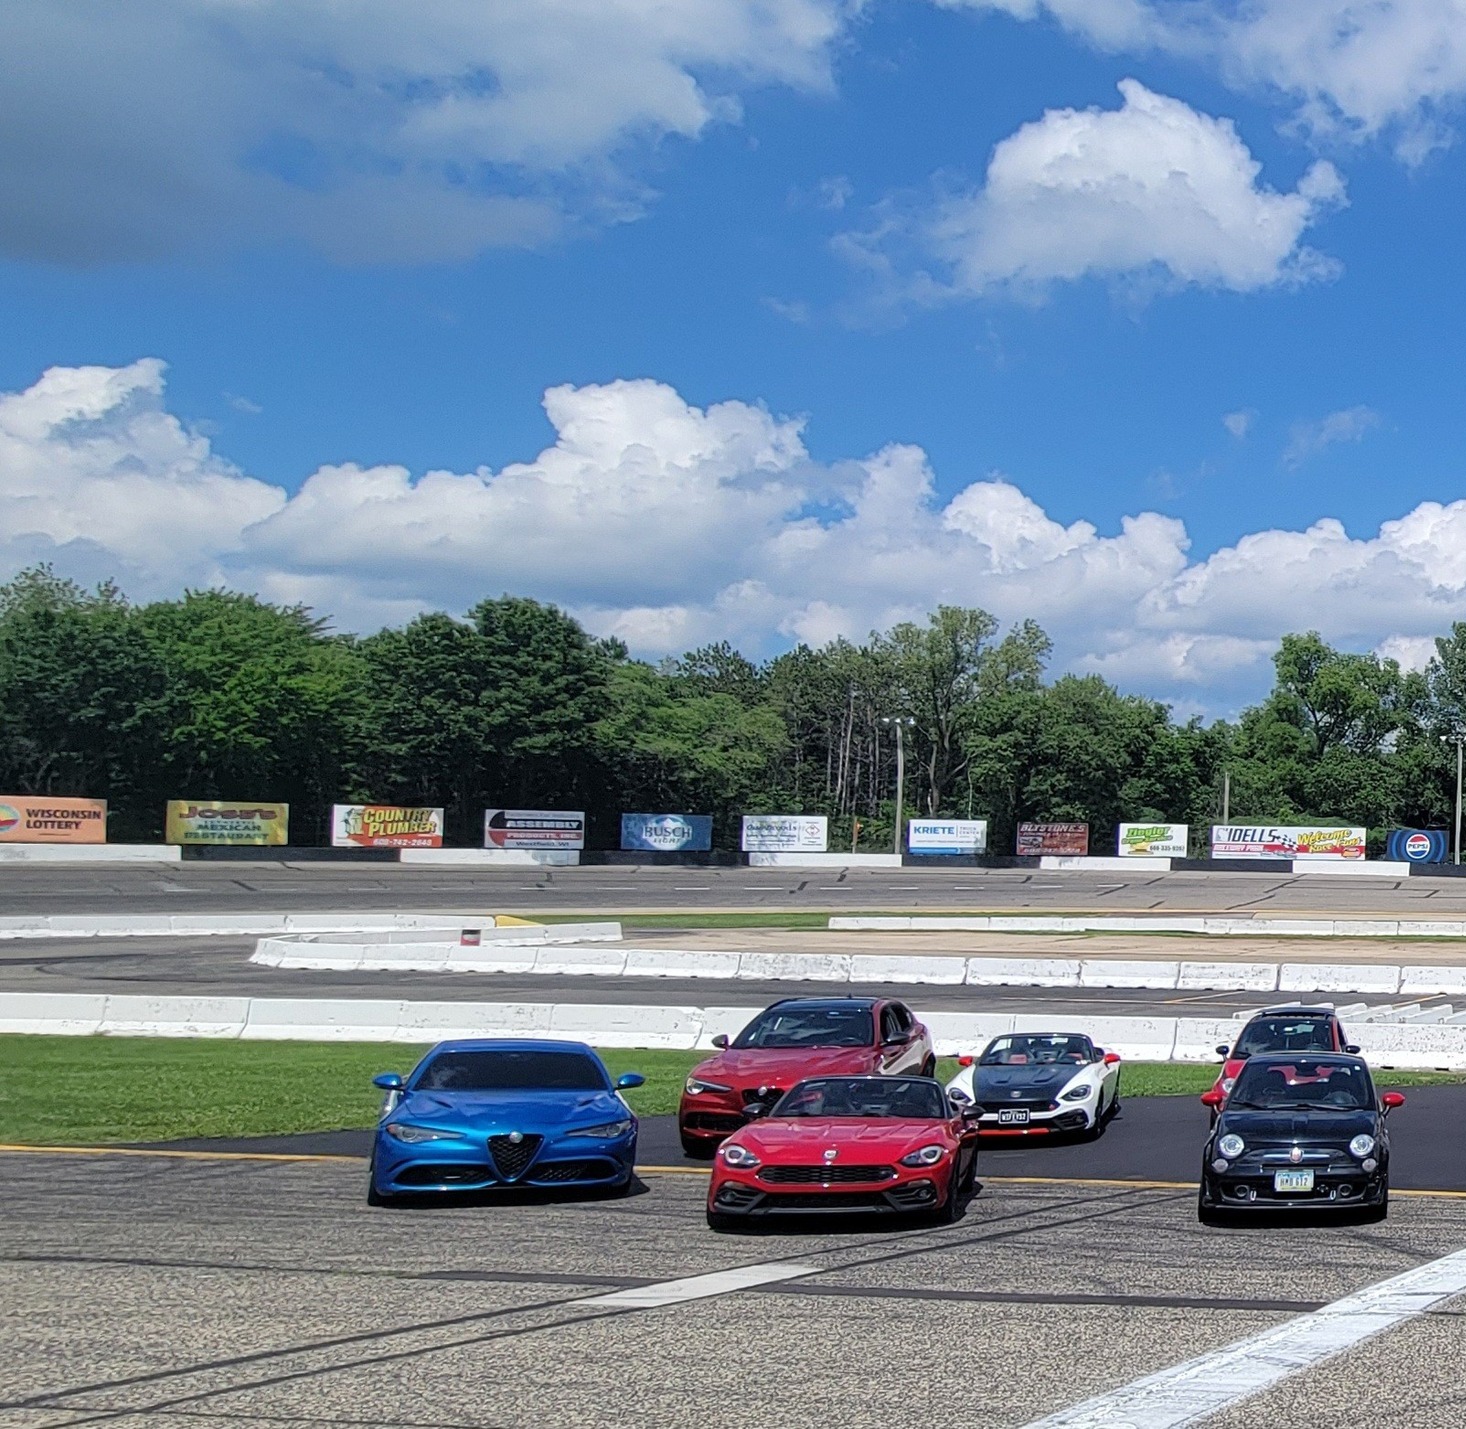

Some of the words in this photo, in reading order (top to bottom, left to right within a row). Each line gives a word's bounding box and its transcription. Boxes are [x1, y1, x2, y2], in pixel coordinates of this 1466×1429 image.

[26, 808, 102, 820] WISCONSIN
[364, 808, 434, 824] COUNTRY
[26, 820, 82, 830] LOTTERY
[368, 820, 437, 838] PLUMBER
[506, 820, 580, 829] ASSEMBLY
[913, 826, 955, 835] KRIETE
[644, 826, 691, 839] BUSCH
[1297, 829, 1353, 846] Welcome
